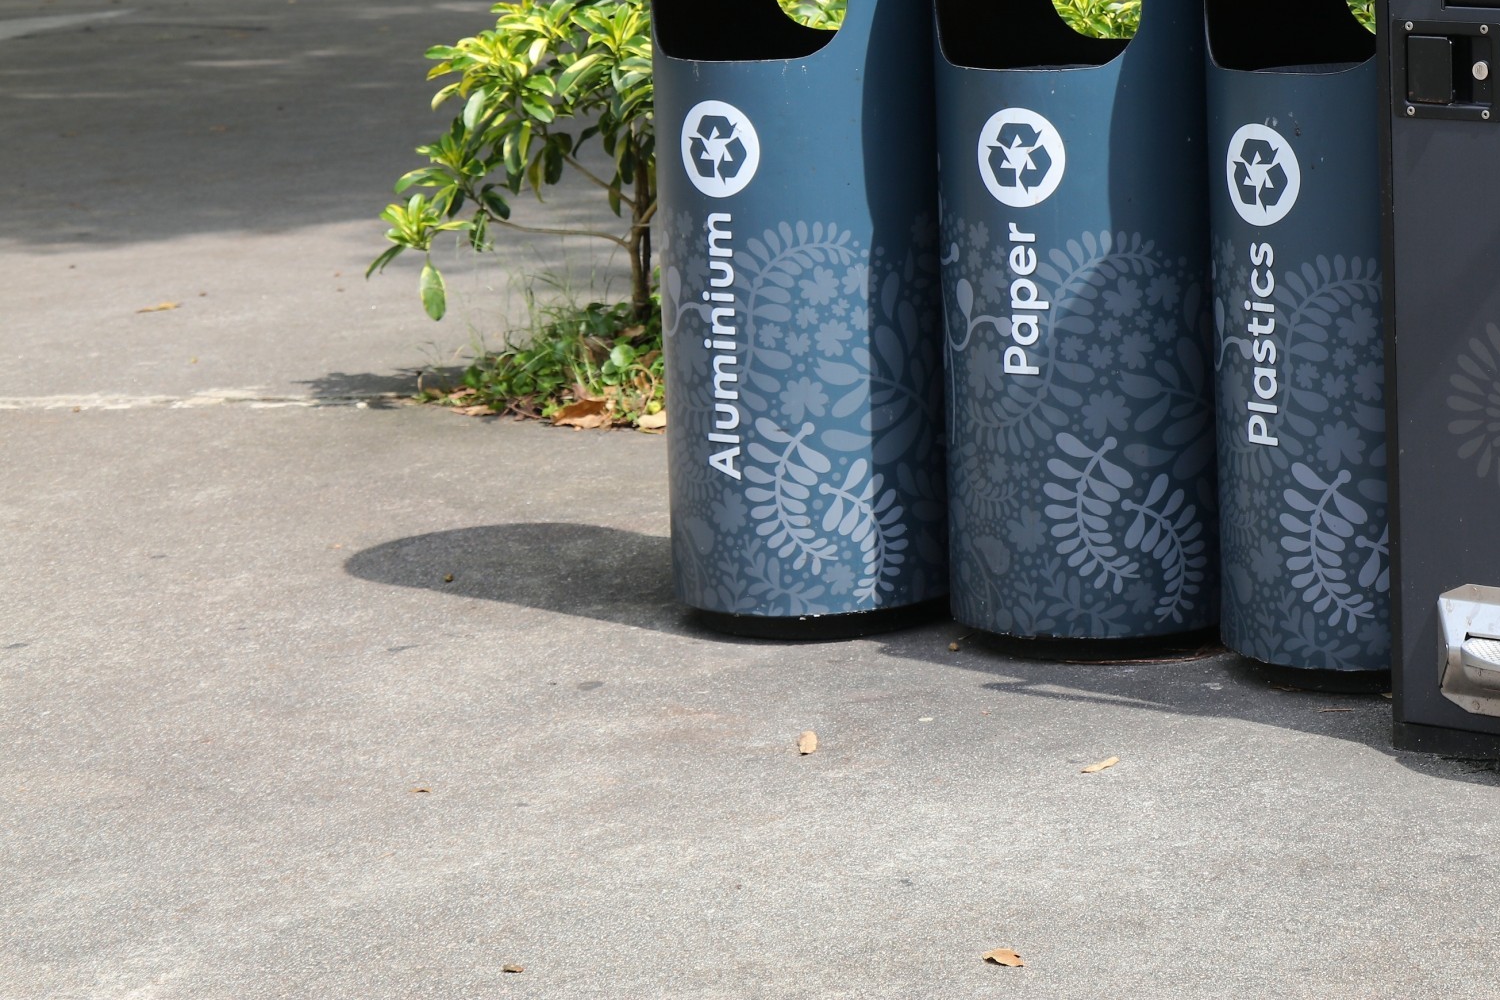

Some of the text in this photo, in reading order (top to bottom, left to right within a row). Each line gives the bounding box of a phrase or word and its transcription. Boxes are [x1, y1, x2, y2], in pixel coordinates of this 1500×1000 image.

[703, 212, 742, 481] Aluminium
[1003, 222, 1050, 376] Paper
[1244, 242, 1279, 446] Plastics
